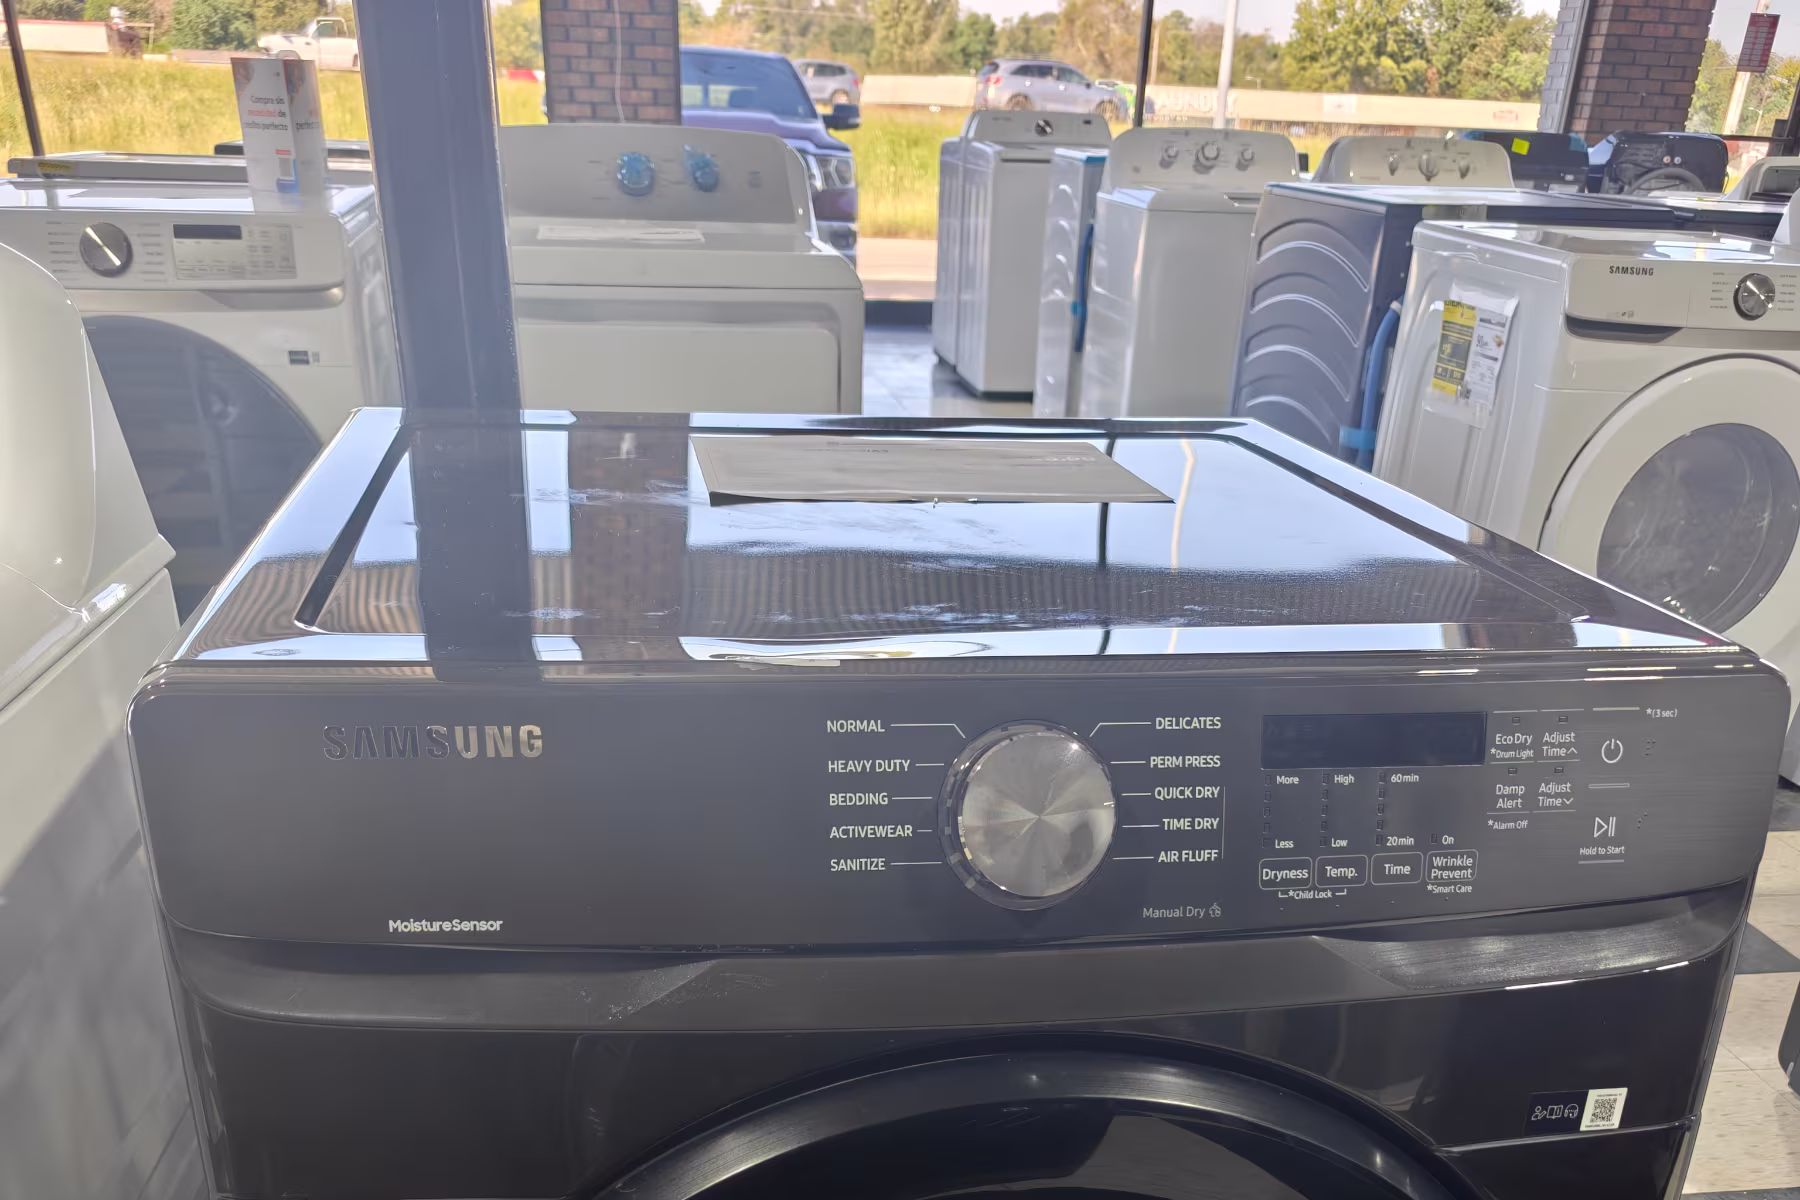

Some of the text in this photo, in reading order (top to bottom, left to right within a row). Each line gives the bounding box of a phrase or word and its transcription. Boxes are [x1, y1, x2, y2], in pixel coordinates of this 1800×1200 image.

[1609, 265, 1654, 276] SAMSUNG
[826, 720, 886, 733] NORMAL
[1155, 716, 1222, 730] DELICATES
[322, 724, 544, 760] SAMSUNG
[1543, 731, 1575, 745] Adjust
[1516, 748, 1534, 760] Light
[1542, 746, 1567, 757] Time
[828, 759, 911, 773] HEAVY DUTY
[1150, 755, 1221, 769] PERM PRESS
[1276, 775, 1300, 785] More
[1334, 774, 1355, 786] High
[1154, 786, 1220, 801] QUICK DRY
[1495, 784, 1525, 797] Damp
[1539, 782, 1571, 796] Adjust
[829, 792, 888, 806] BEDDING
[1496, 796, 1522, 809] Alert
[1538, 796, 1562, 807] Time
[1162, 817, 1219, 831] TIME DRY
[1515, 820, 1529, 830] Off
[829, 825, 913, 839] ACTIVEWEAR
[1275, 838, 1294, 849] Less
[1331, 837, 1348, 848] Low
[1442, 834, 1455, 845] On
[1157, 850, 1219, 863] AIR FLUFF
[1579, 846, 1597, 856] Hold
[1606, 845, 1625, 855] Start
[830, 858, 886, 872] SANITIZE
[1432, 855, 1473, 867] Wrinkle
[1262, 868, 1309, 883] Dryness
[1325, 865, 1358, 880] Temp.
[1384, 864, 1411, 875] Time
[1431, 867, 1472, 880] Prevent
[1314, 888, 1333, 899] Lock
[1455, 883, 1473, 893] Care
[1142, 905, 1206, 919] Manual Dry
[388, 918, 504, 933] MoistureSensor
